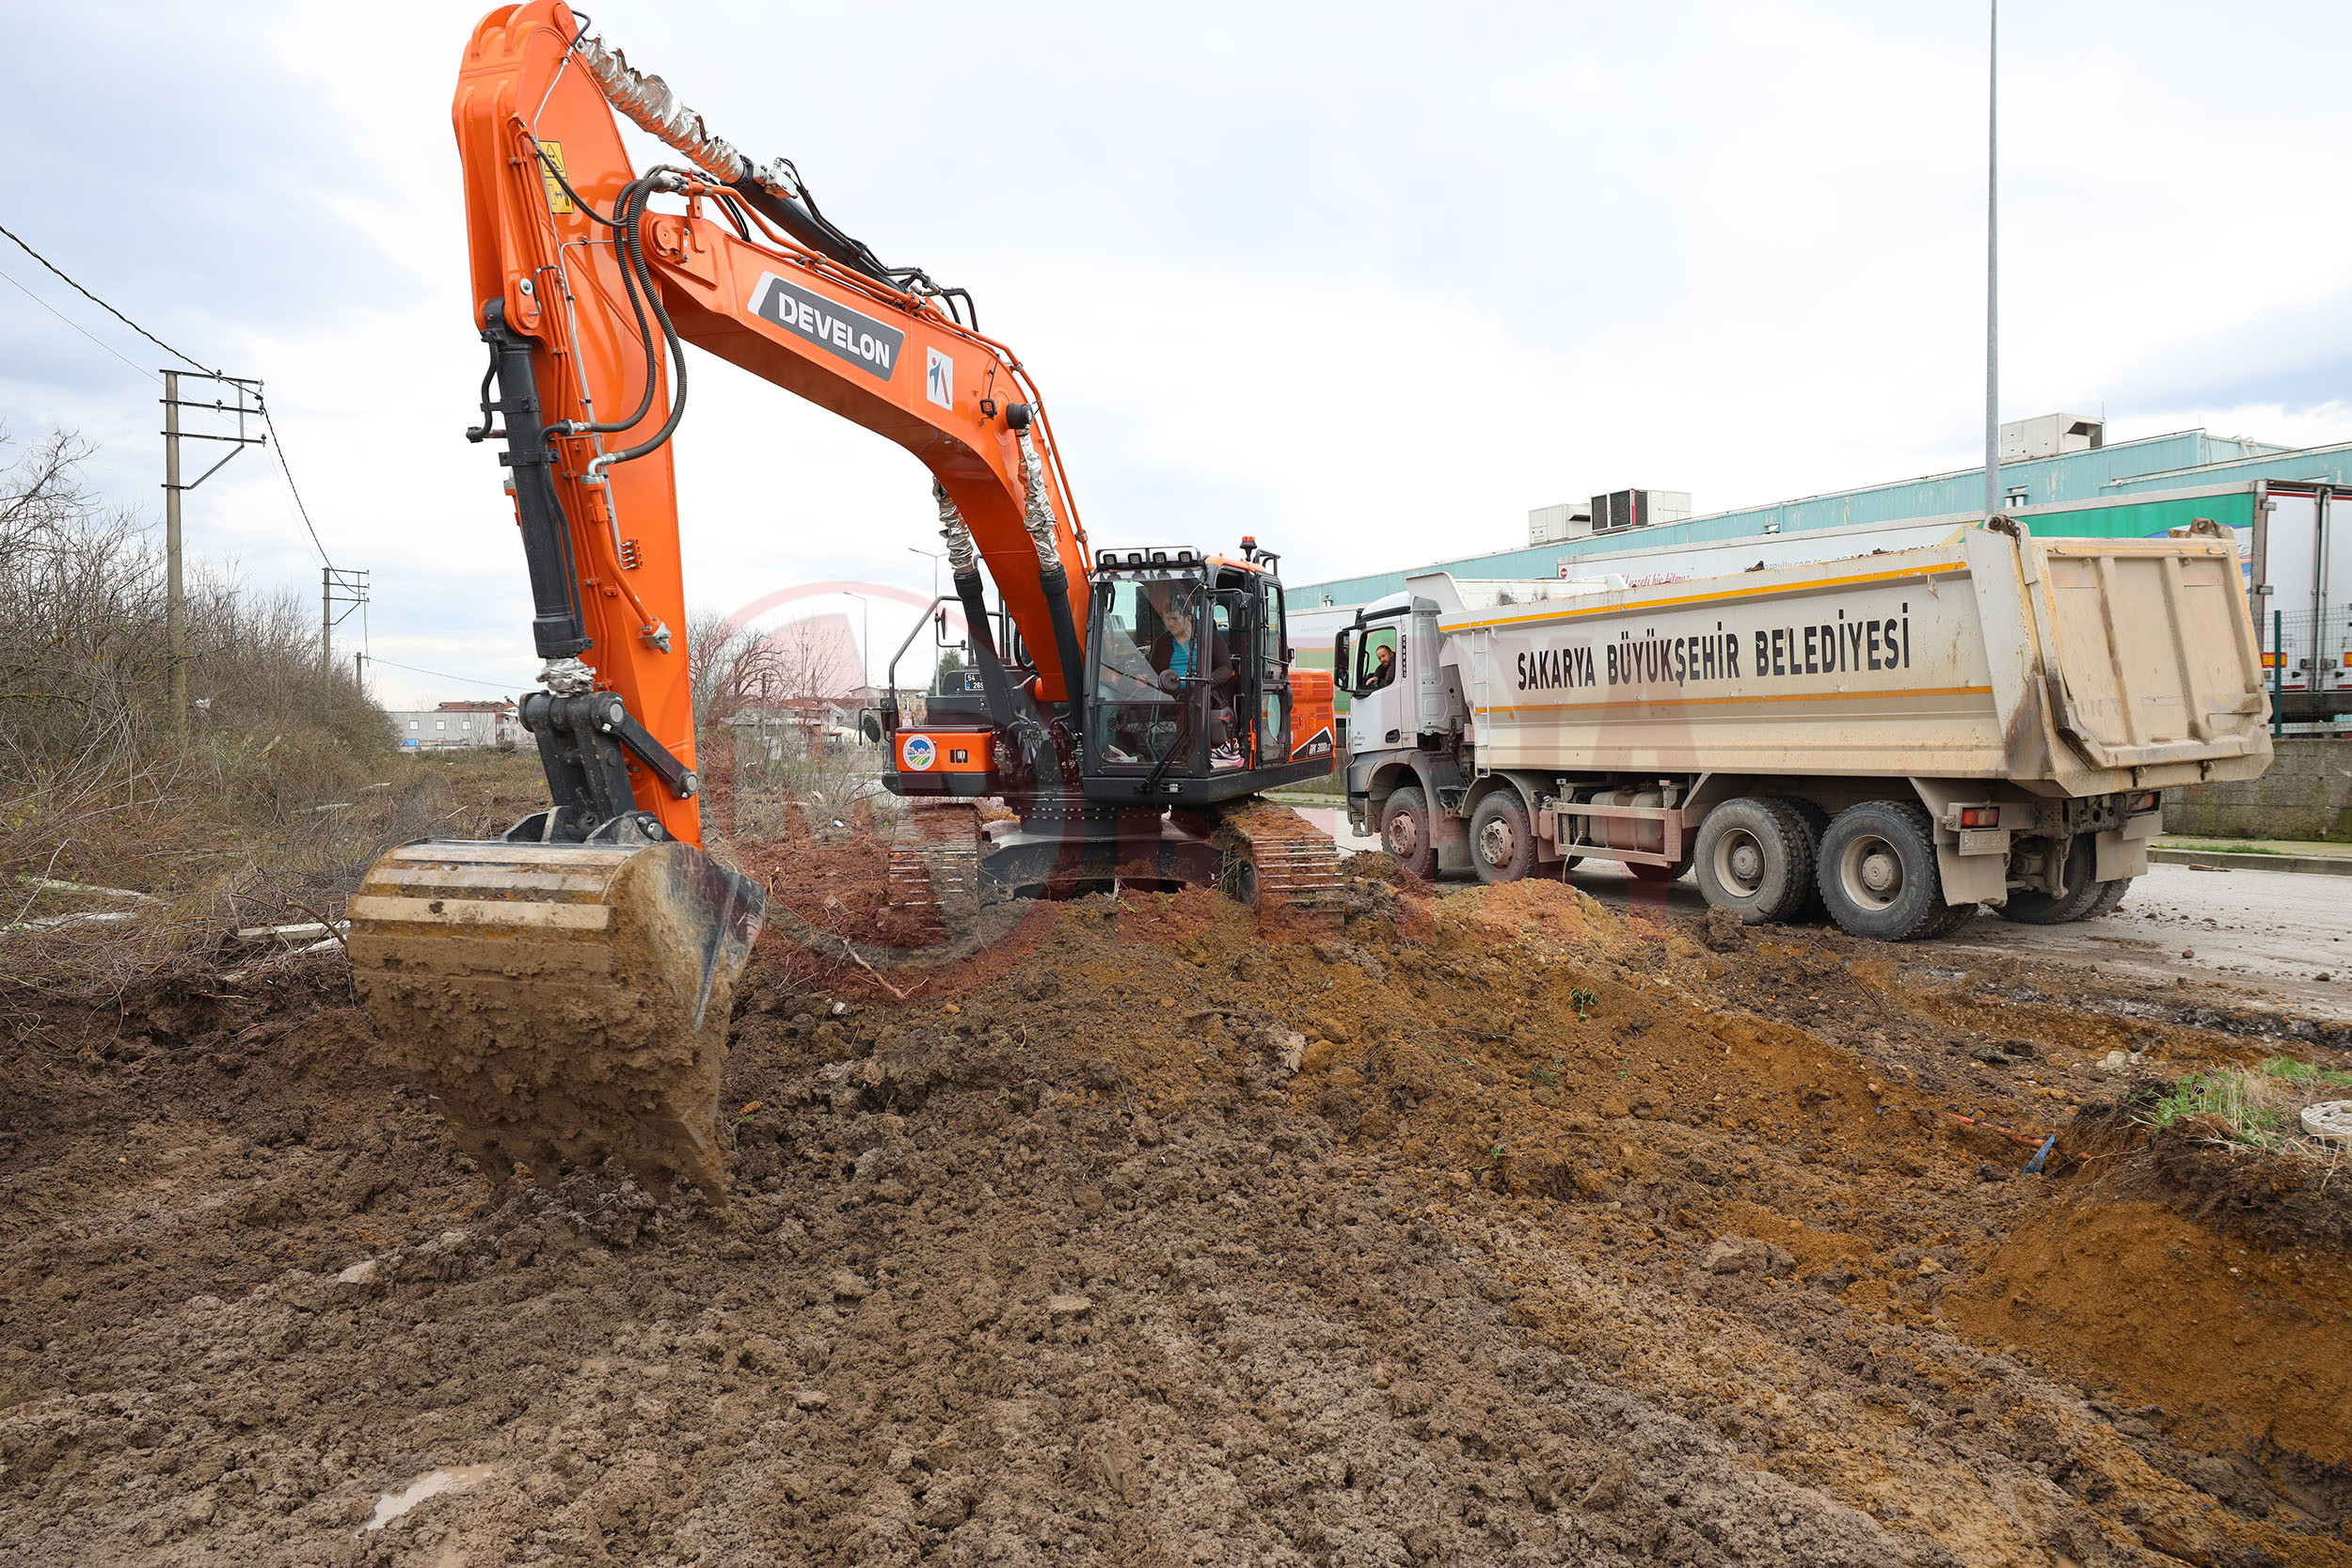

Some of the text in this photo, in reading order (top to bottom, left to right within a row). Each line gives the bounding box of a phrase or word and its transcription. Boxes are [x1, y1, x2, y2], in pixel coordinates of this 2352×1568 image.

[779, 292, 889, 370] DEVELON
[1518, 602, 1911, 691] SAKARYA BÜYÜKŞEHİR BELEDİYESİ
